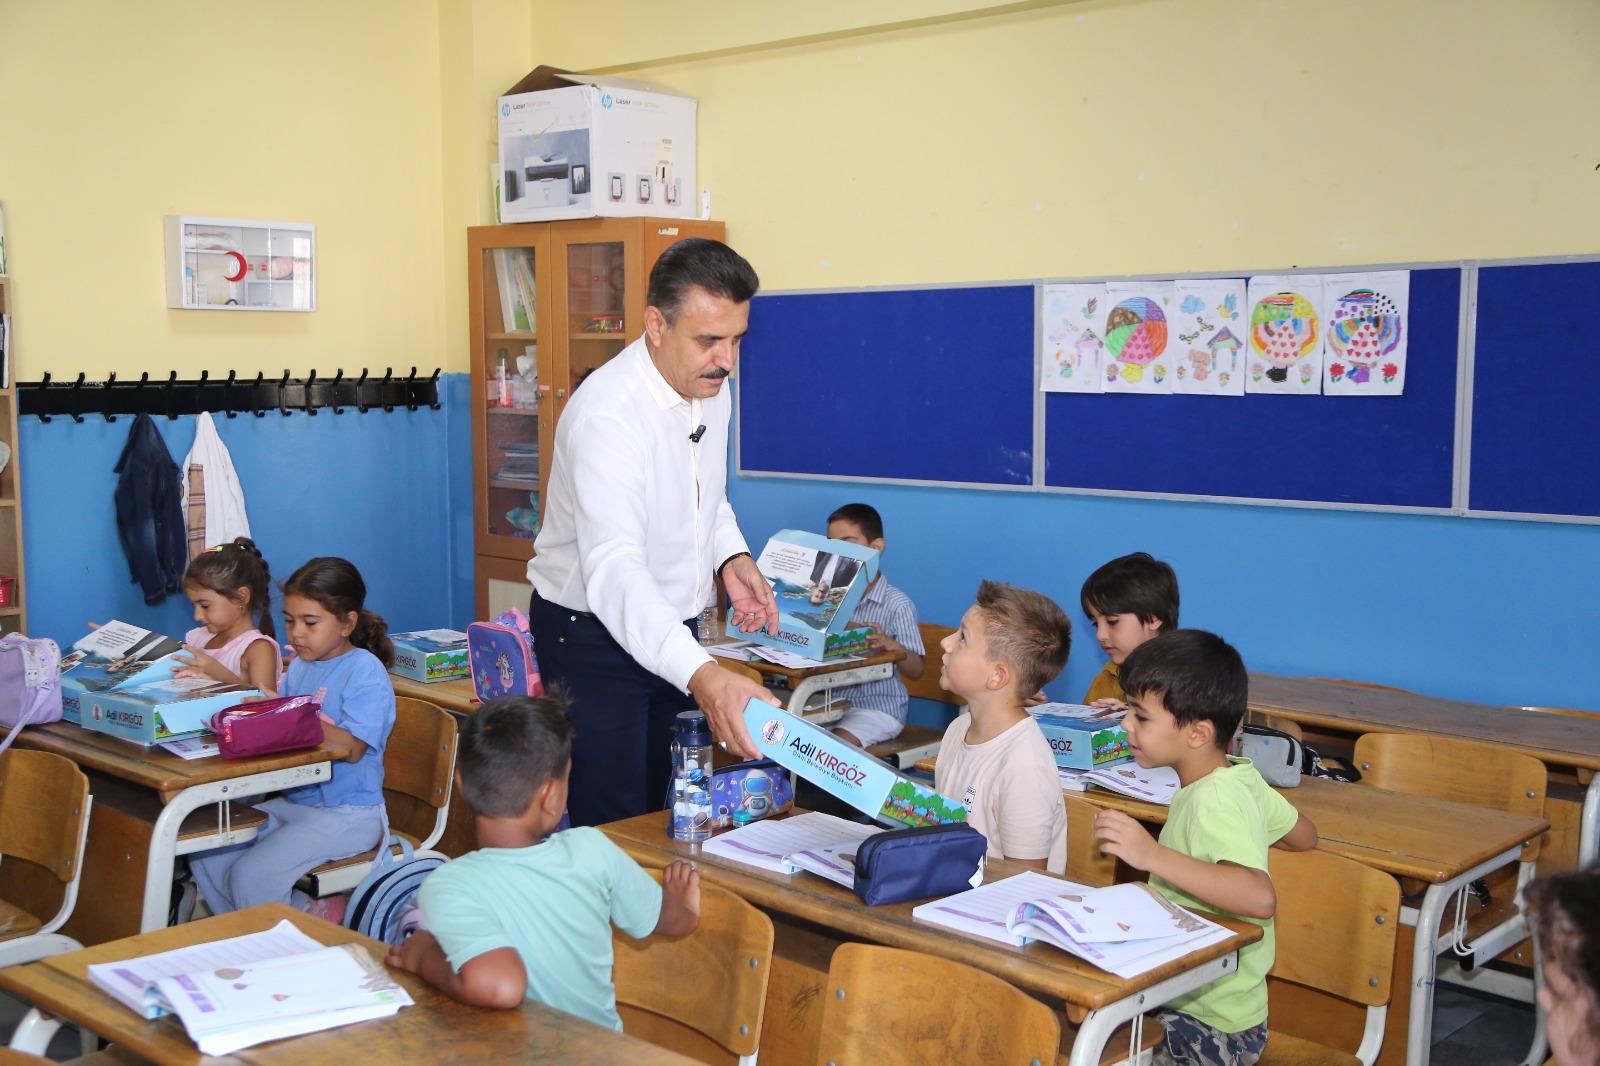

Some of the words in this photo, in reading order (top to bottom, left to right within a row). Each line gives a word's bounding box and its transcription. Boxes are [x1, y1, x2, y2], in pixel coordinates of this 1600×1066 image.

[777, 630, 810, 646] KIRGÖZ
[106, 709, 118, 721] Adil
[118, 711, 144, 726] KIRGÖZ
[1046, 737, 1073, 752] GÖZ
[789, 736, 817, 758] Adil
[815, 748, 868, 787] KIRGÖZ
